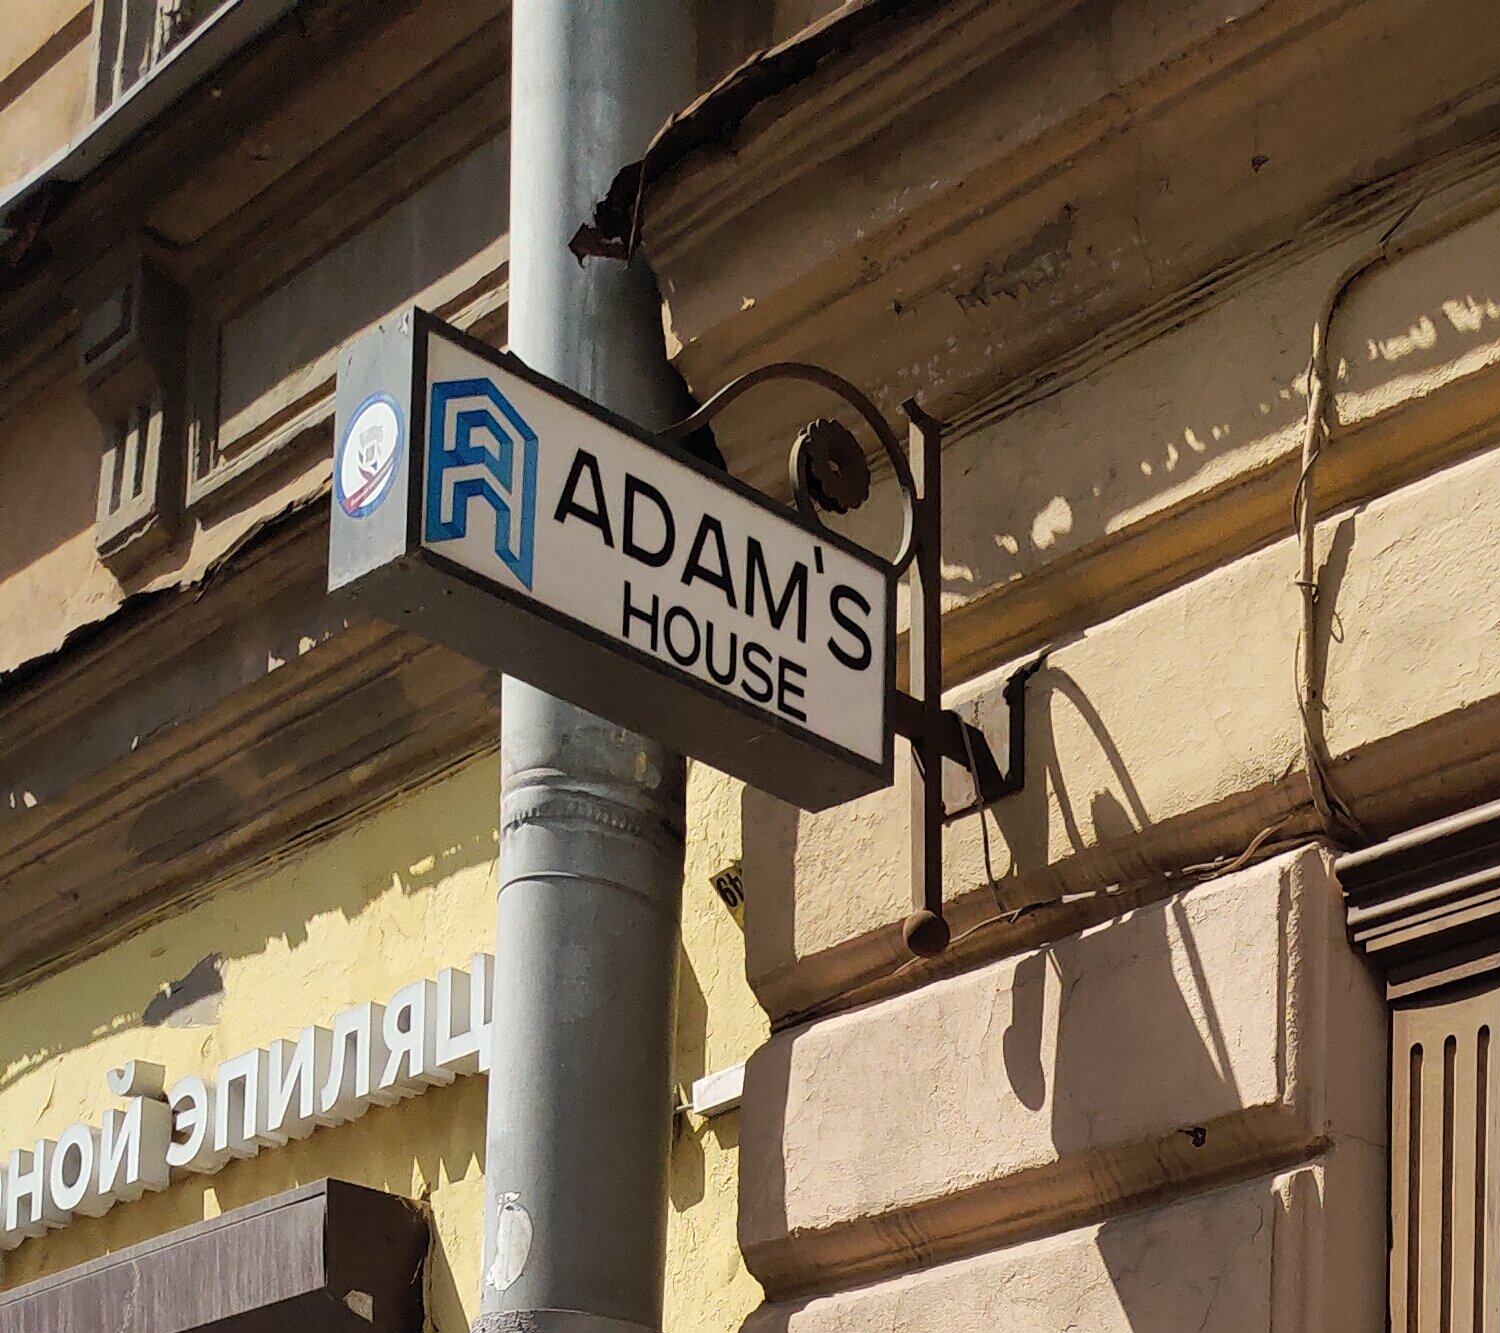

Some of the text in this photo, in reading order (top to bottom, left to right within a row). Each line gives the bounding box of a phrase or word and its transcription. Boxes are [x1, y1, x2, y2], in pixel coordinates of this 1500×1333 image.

[554, 448, 872, 671] ADAM'S
[622, 580, 807, 722] HOUSE
[0, 953, 492, 1234] НОЙ ЭПИЛЯЦ
